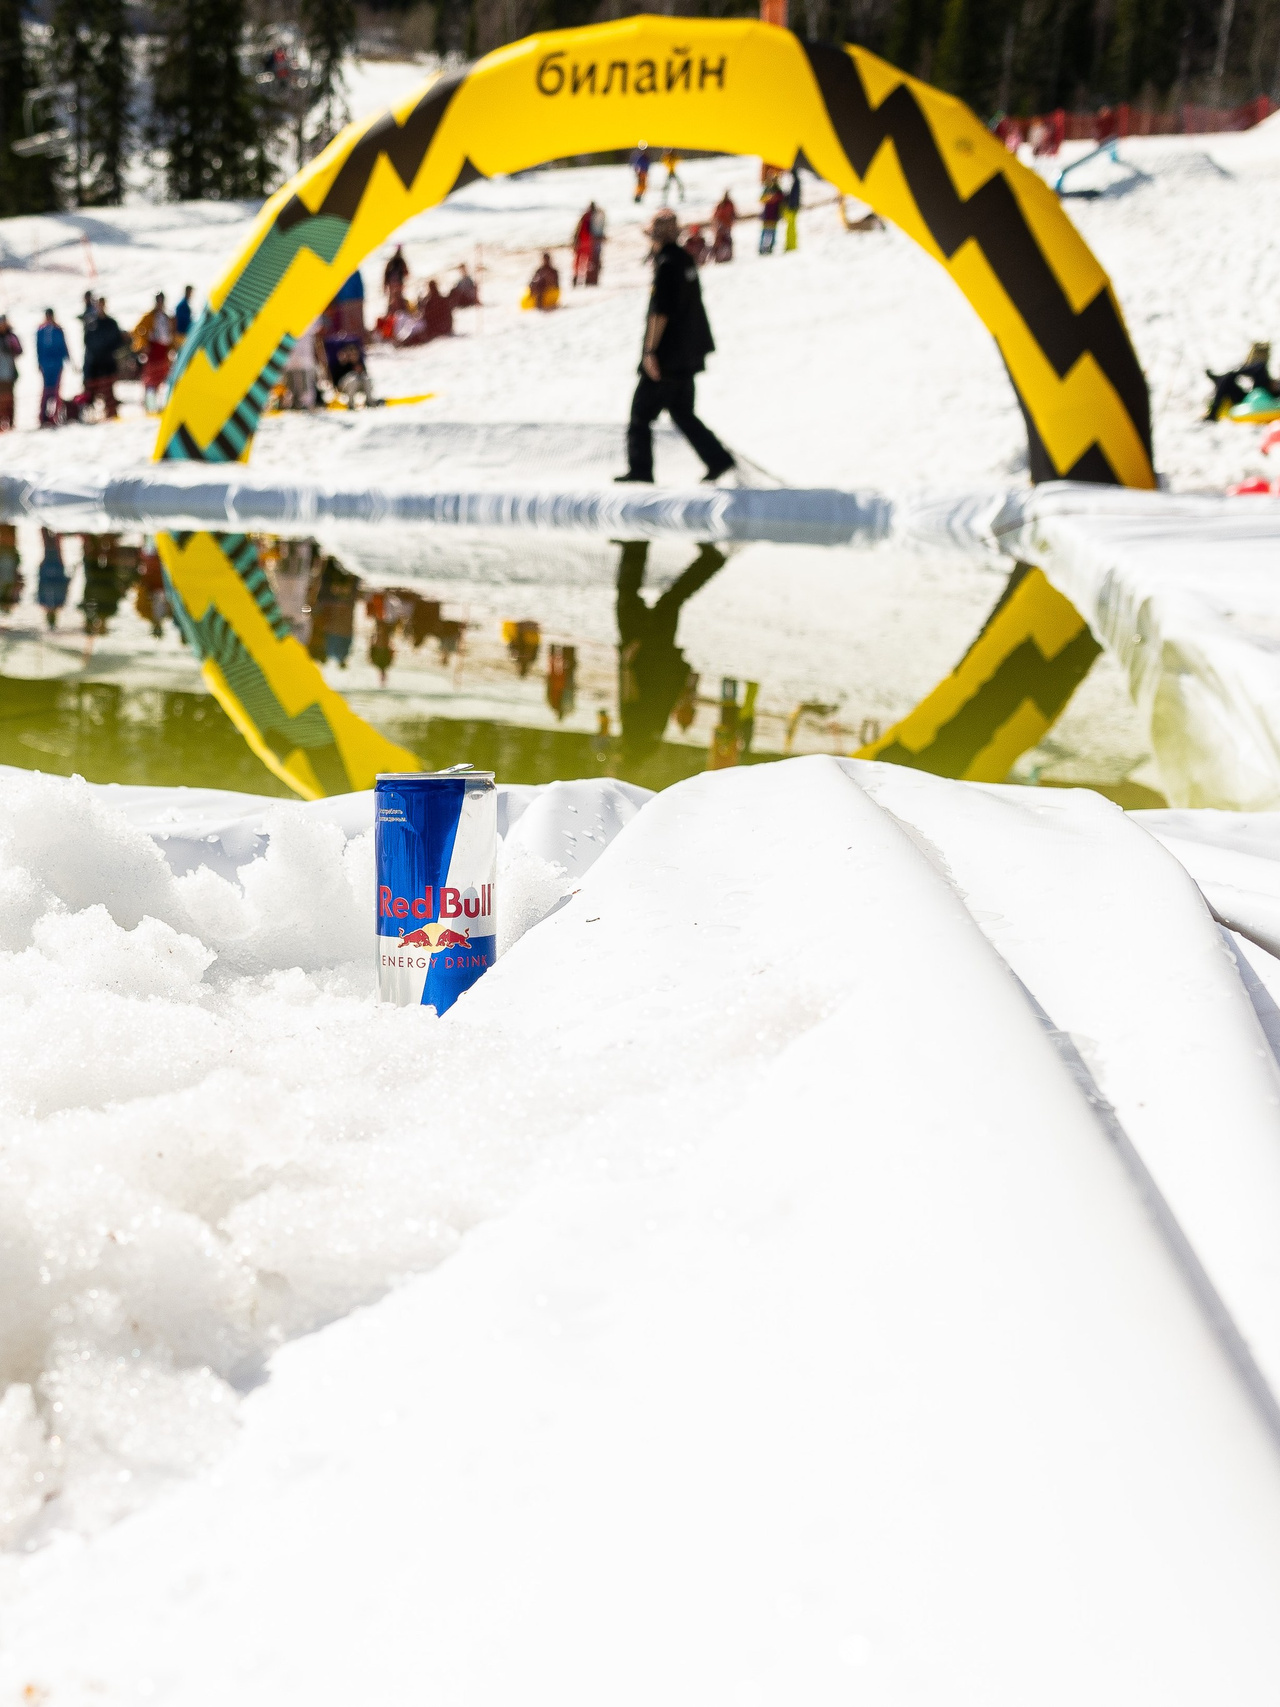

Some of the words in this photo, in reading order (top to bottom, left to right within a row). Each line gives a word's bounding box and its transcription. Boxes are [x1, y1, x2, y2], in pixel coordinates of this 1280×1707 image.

[535, 47, 726, 97] билайн
[380, 885, 433, 919] Red
[440, 883, 492, 918] Bull
[382, 955, 438, 969] ENERGY
[445, 954, 488, 969] DRINK
